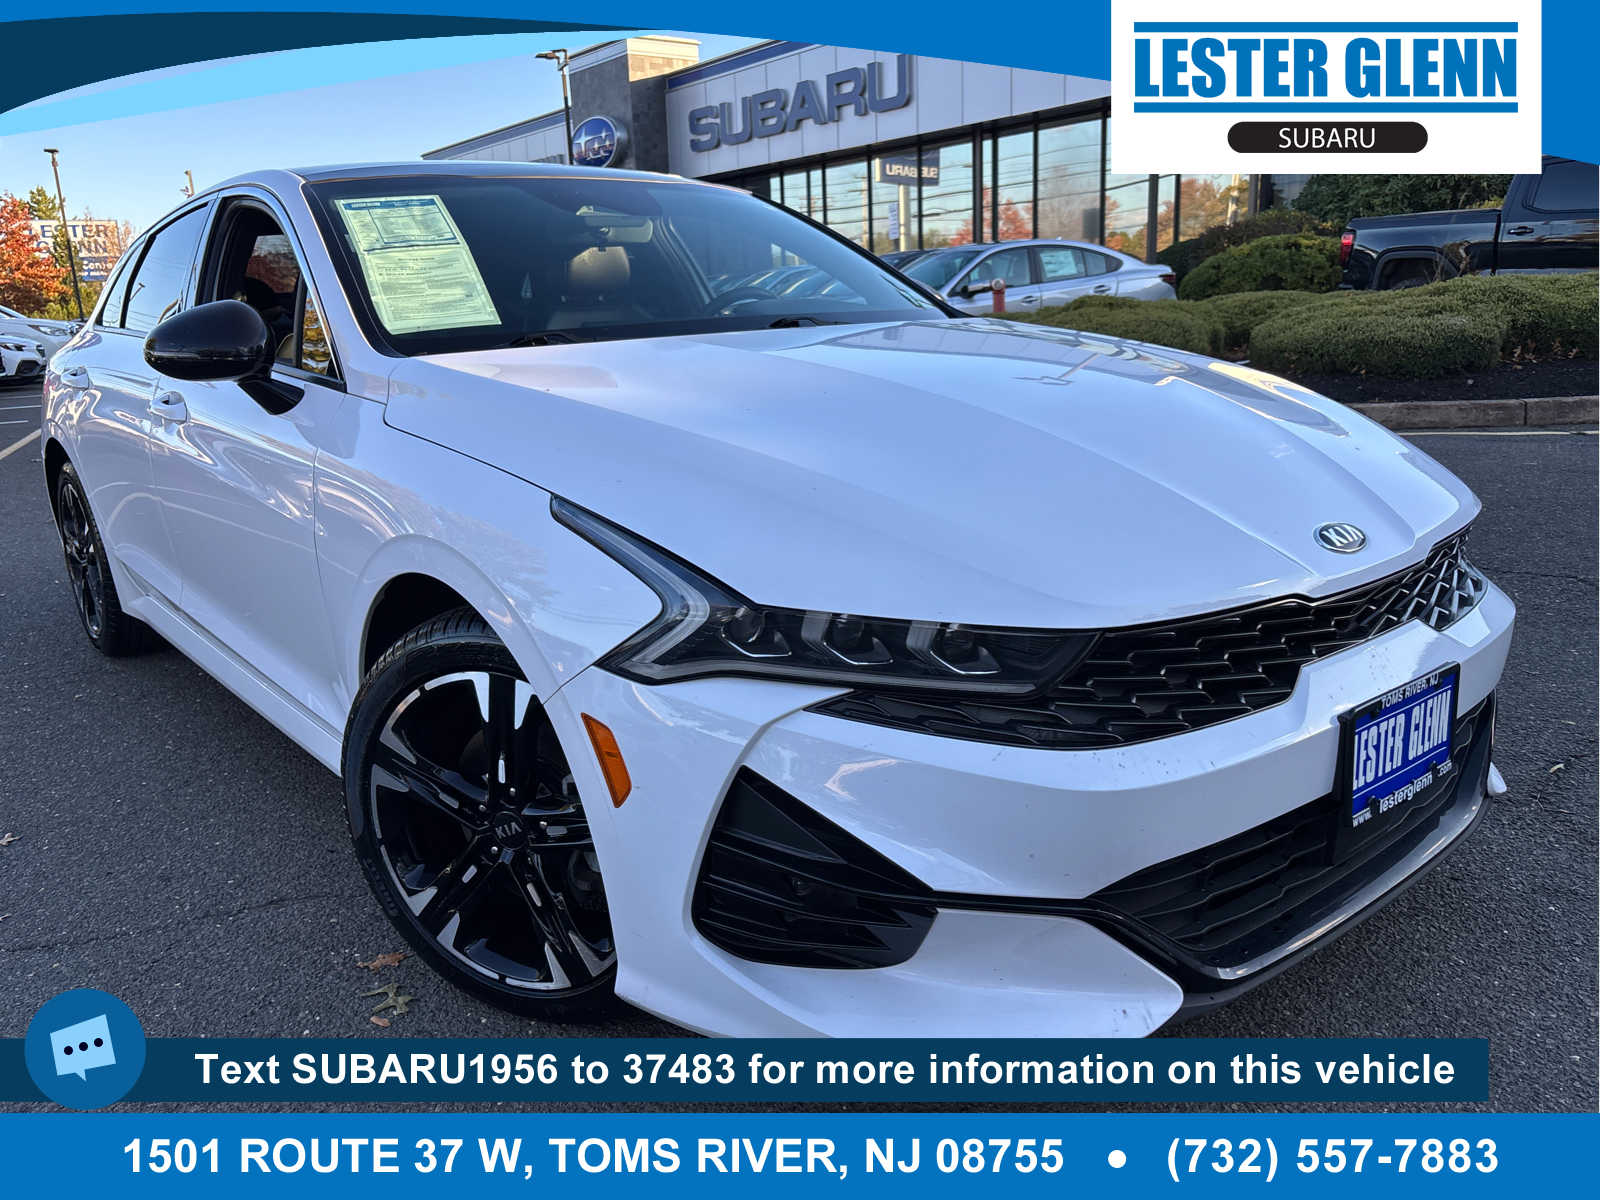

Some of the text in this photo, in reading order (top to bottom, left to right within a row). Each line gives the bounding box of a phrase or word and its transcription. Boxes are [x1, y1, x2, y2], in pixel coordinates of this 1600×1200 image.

[689, 54, 912, 153] SUBARU
[1320, 524, 1364, 547] KIA
[1381, 688, 1403, 709] TOMS
[1429, 671, 1439, 687] NJ
[1352, 690, 1451, 791] LESTER GLENN
[495, 822, 522, 839] KIA
